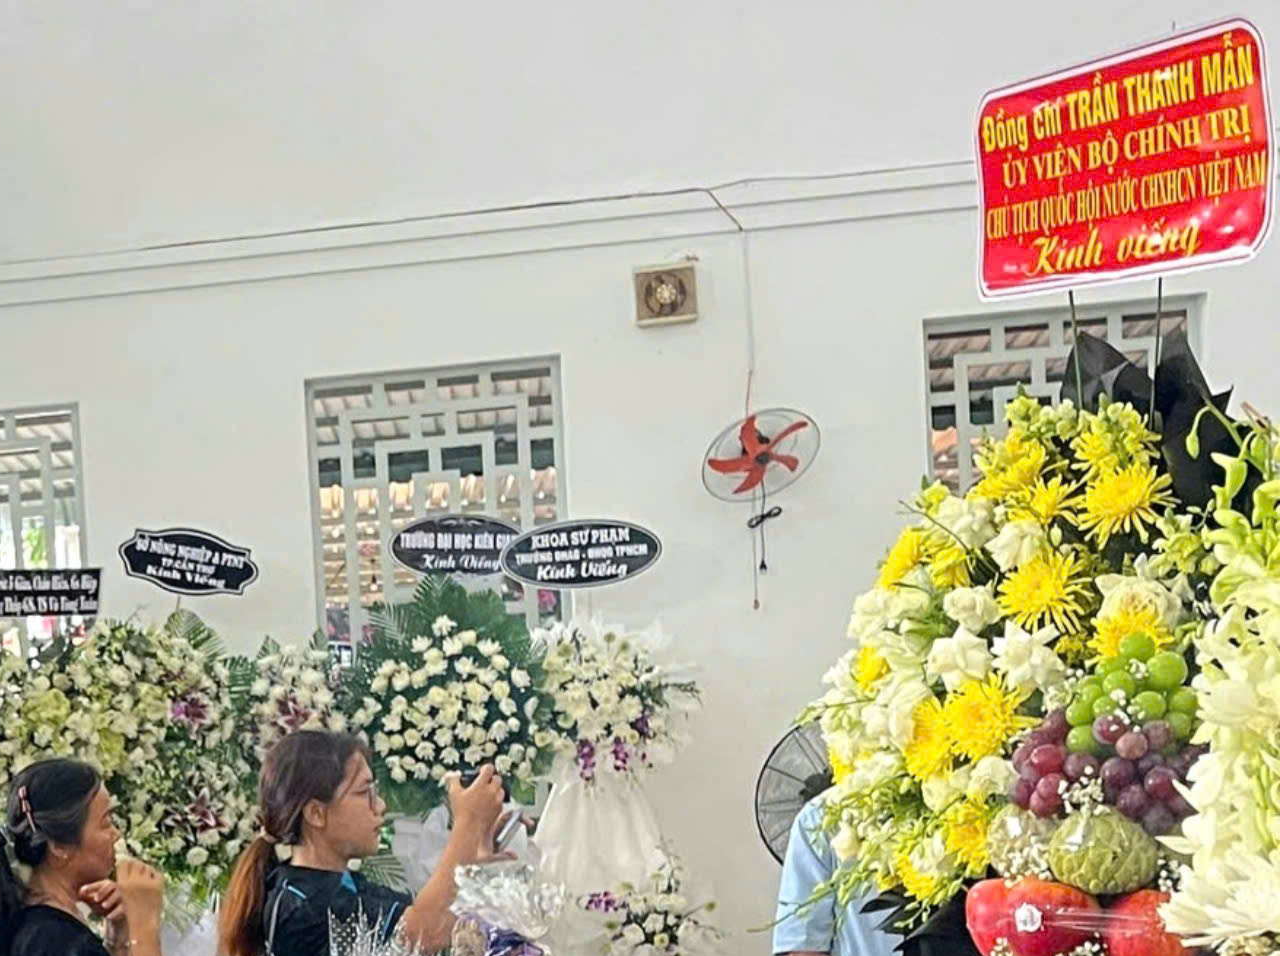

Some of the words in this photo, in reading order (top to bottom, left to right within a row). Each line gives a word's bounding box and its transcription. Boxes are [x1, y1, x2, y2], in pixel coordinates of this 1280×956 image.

[983, 107, 1029, 152] Đồng
[1066, 72, 1119, 131] TRẦN
[1123, 60, 1196, 117] THANH
[1201, 32, 1255, 97] MẪN
[1003, 152, 1029, 189] ỦY
[1033, 141, 1083, 181] VIÊN
[1088, 129, 1120, 175] BỘ
[1123, 114, 1202, 161] CHÍNH
[1207, 104, 1252, 144] TRỊ
[986, 193, 1011, 239] CHỦ
[1012, 199, 1039, 246] TỊCH
[1040, 177, 1075, 237] QUỐC
[1077, 178, 1101, 231] HỘI
[1102, 169, 1139, 216] NƯỚC
[1140, 163, 1197, 211] CHXHCN
[1199, 150, 1233, 207] VIỆT
[1233, 150, 1266, 191] NAM
[531, 531, 569, 550] KHOA
[591, 527, 630, 546] PHẠM
